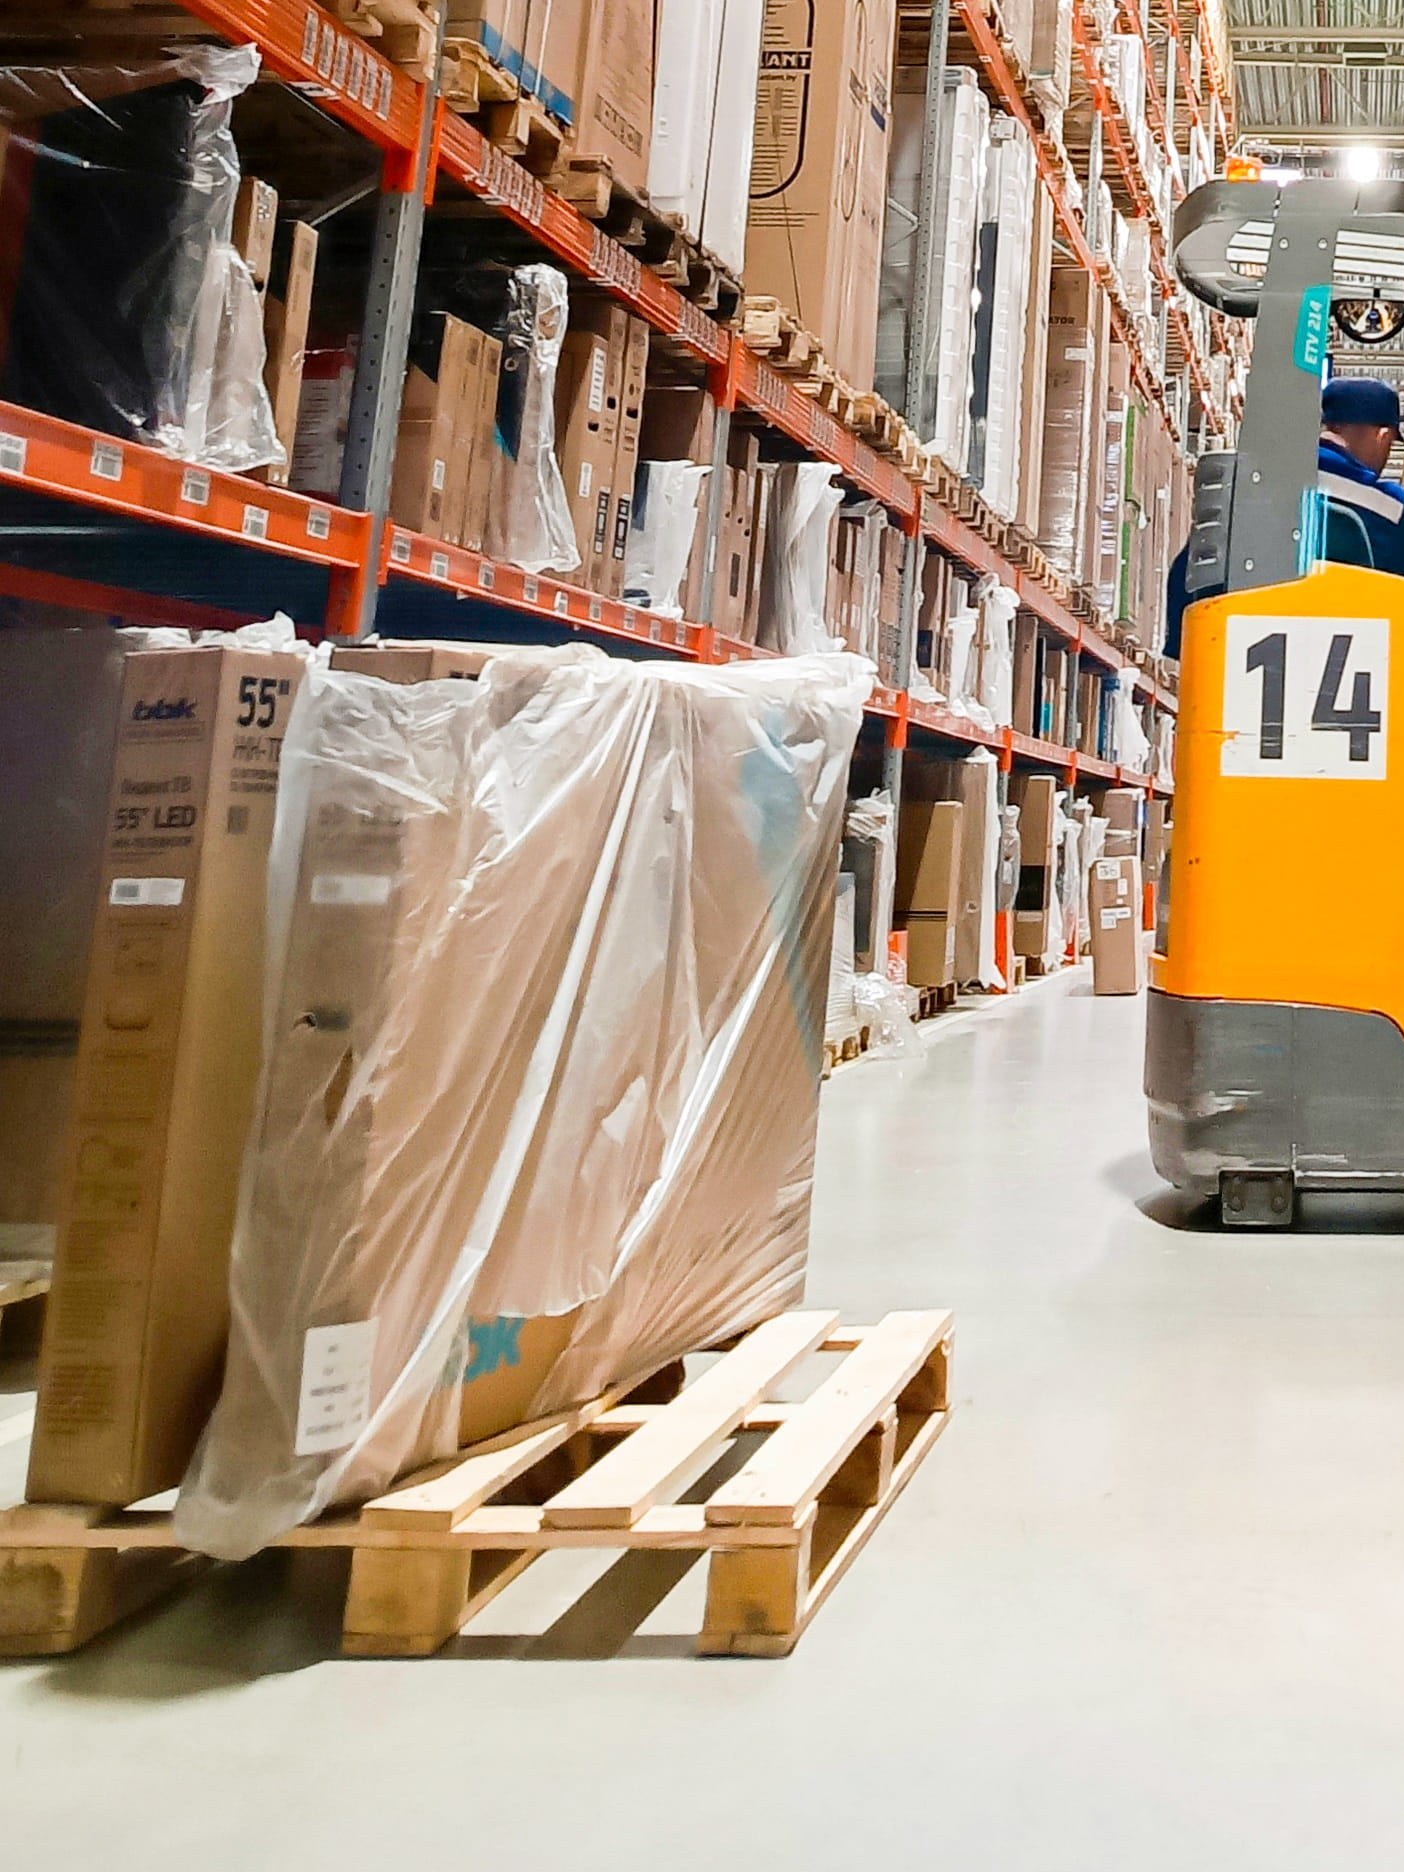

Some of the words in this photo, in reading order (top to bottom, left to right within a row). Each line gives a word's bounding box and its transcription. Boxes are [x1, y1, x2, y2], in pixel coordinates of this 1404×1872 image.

[1308, 300, 1323, 331] 214
[1304, 332, 1319, 365] ETV
[237, 675, 291, 728] 55"
[1246, 632, 1382, 762] 14
[153, 804, 198, 829] LED
